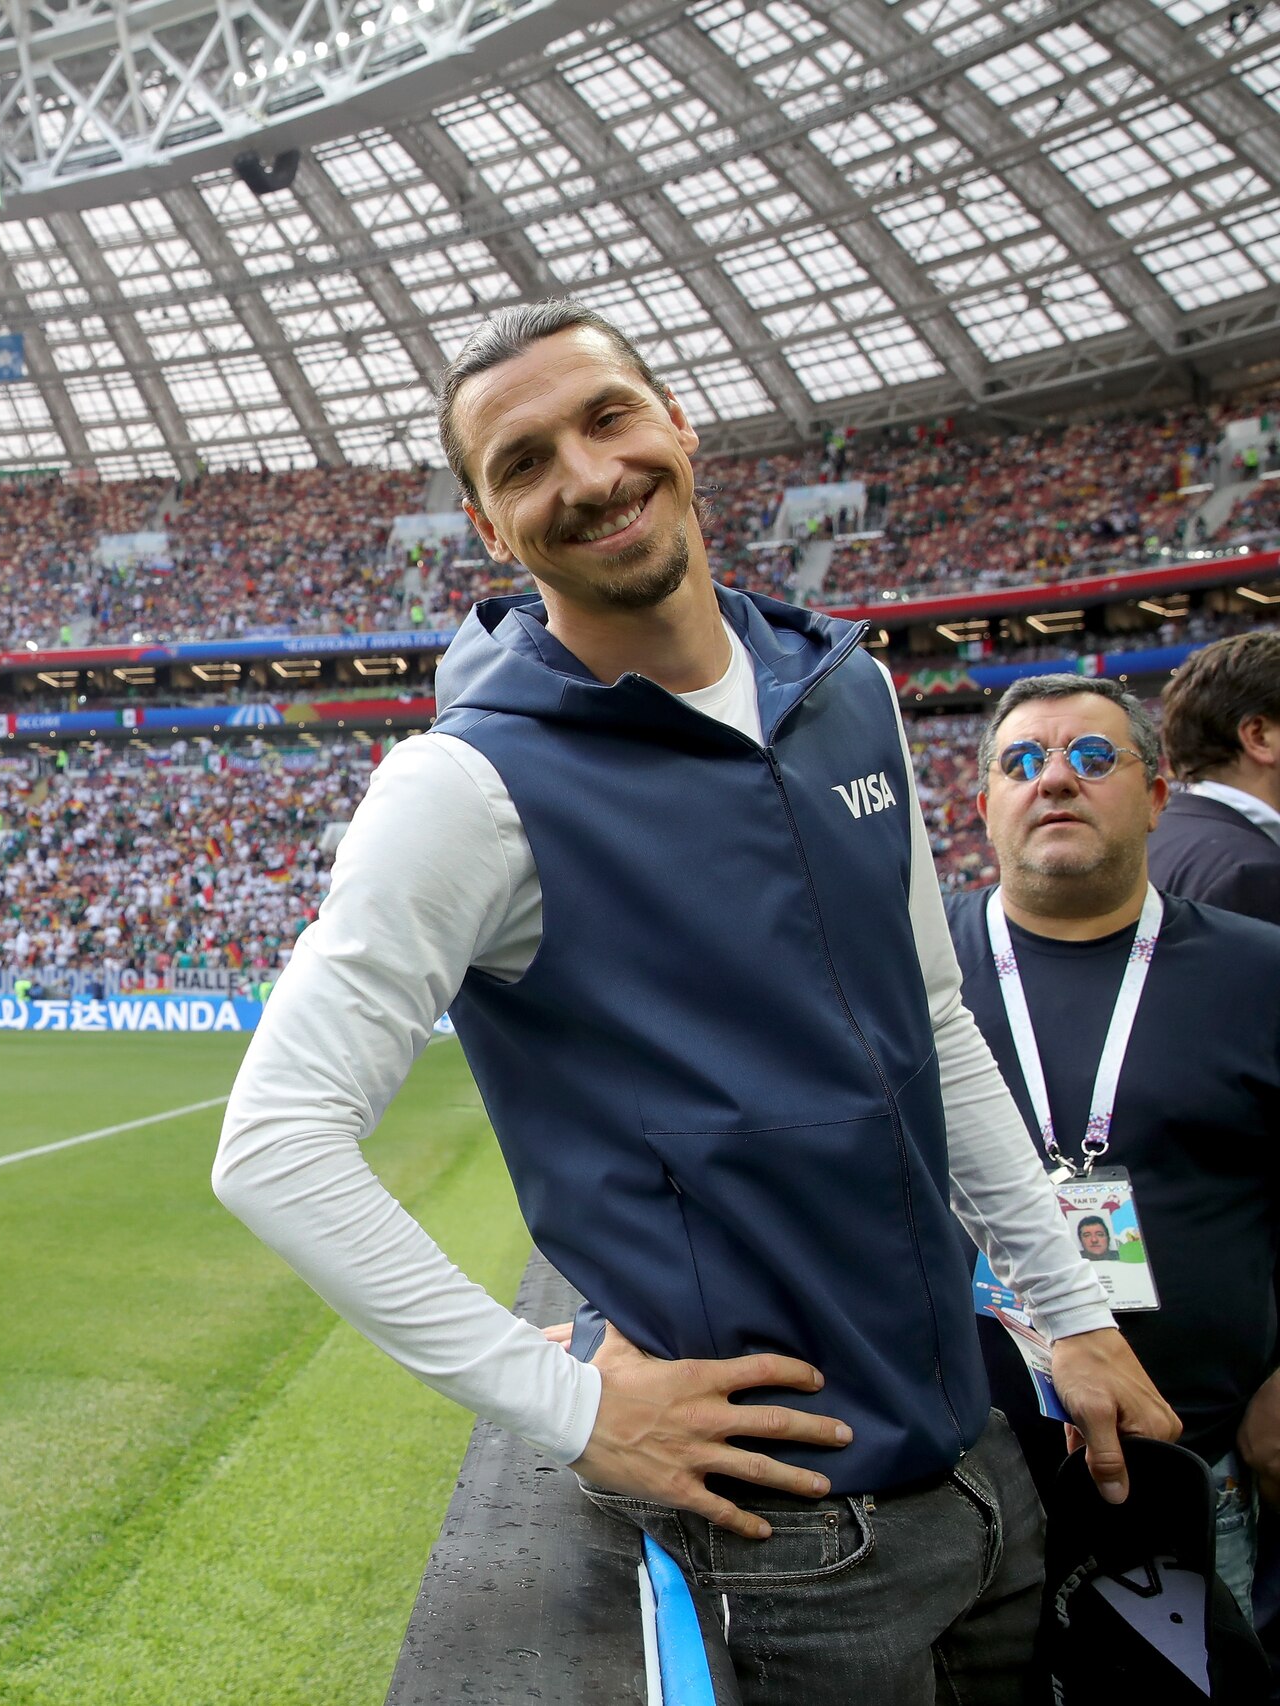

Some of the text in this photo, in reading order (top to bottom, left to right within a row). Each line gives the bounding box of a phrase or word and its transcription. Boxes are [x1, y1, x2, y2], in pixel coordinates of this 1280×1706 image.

[831, 772, 897, 819] VISA
[175, 972, 238, 990] HALLE
[33, 999, 242, 1031] 万达 WANDA
